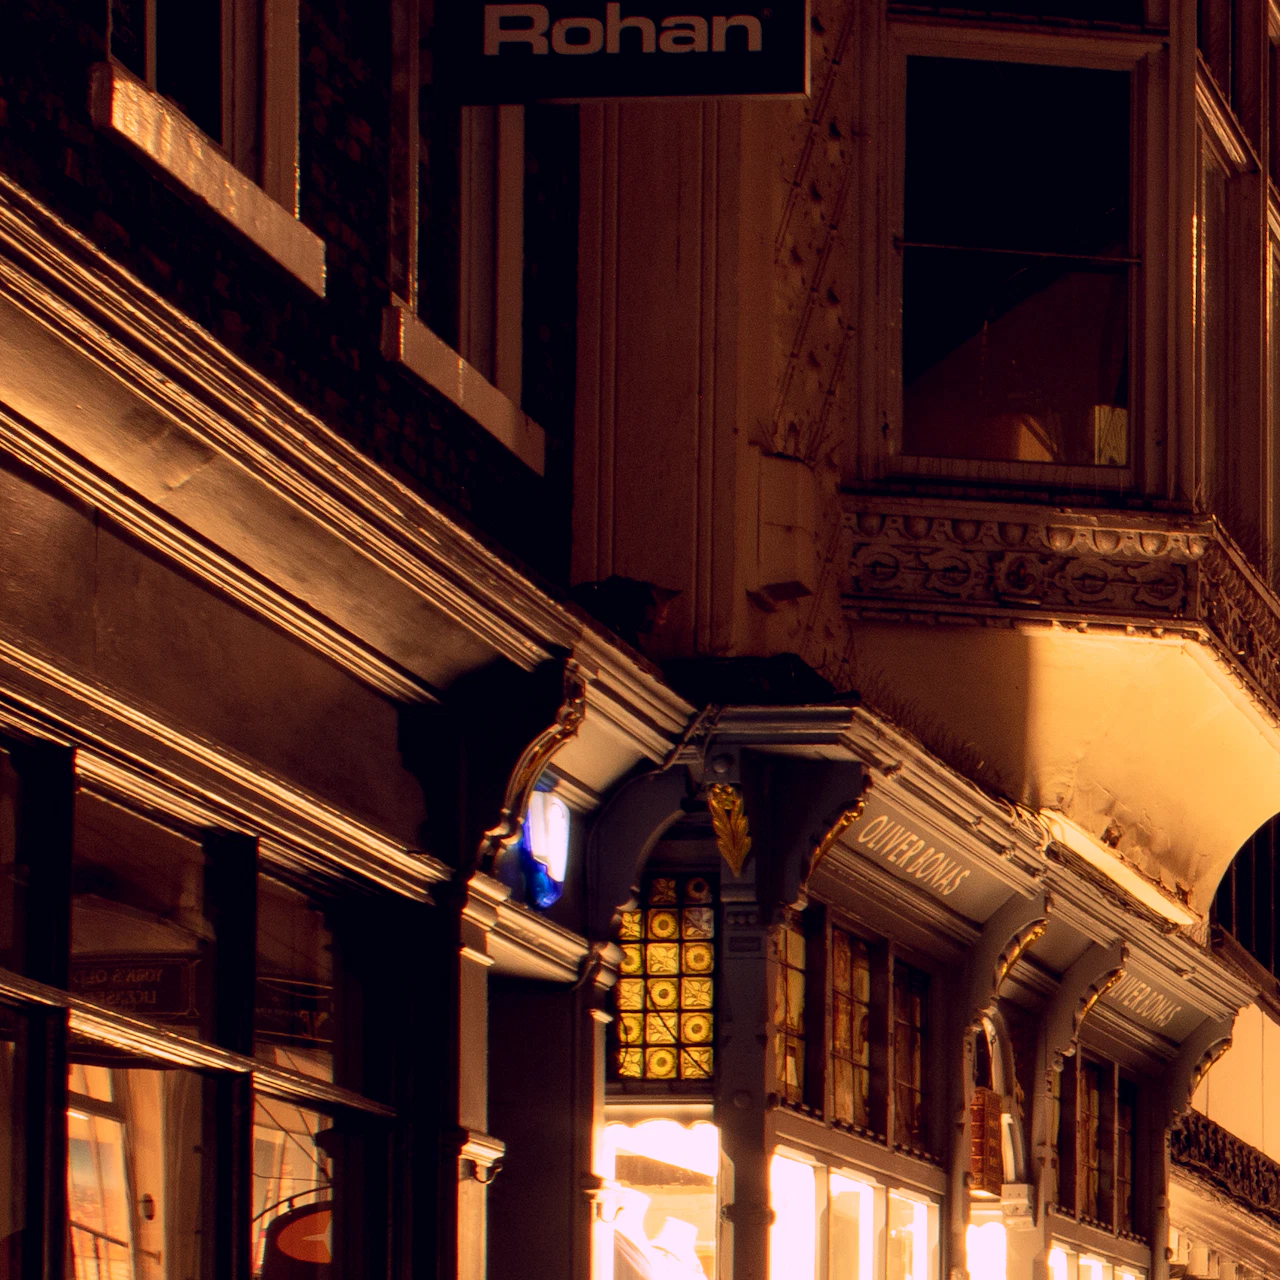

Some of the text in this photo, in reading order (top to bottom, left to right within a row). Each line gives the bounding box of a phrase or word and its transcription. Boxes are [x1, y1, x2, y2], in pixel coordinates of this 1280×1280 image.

[483, 1, 763, 56] Rohan
[857, 814, 972, 896] OLIVER BONAS
[1135, 991, 1183, 1027] BONAS
